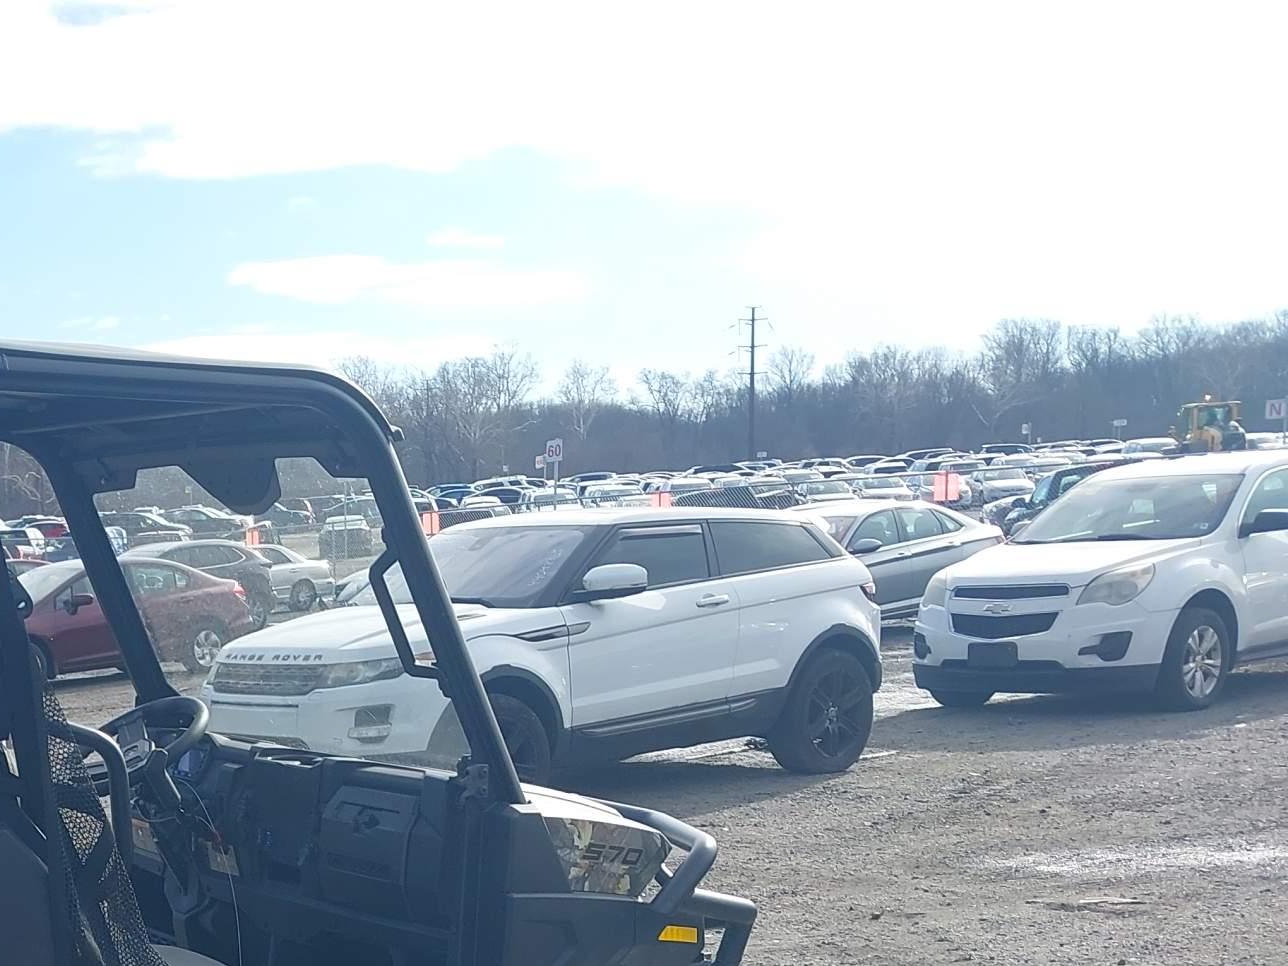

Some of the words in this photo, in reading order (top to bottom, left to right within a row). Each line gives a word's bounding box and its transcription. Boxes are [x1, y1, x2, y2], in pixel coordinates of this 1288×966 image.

[1269, 403, 1283, 417] N
[548, 444, 562, 458] 60
[224, 654, 265, 662] RANGE
[272, 654, 324, 662] ROVER
[582, 843, 644, 865] 570
